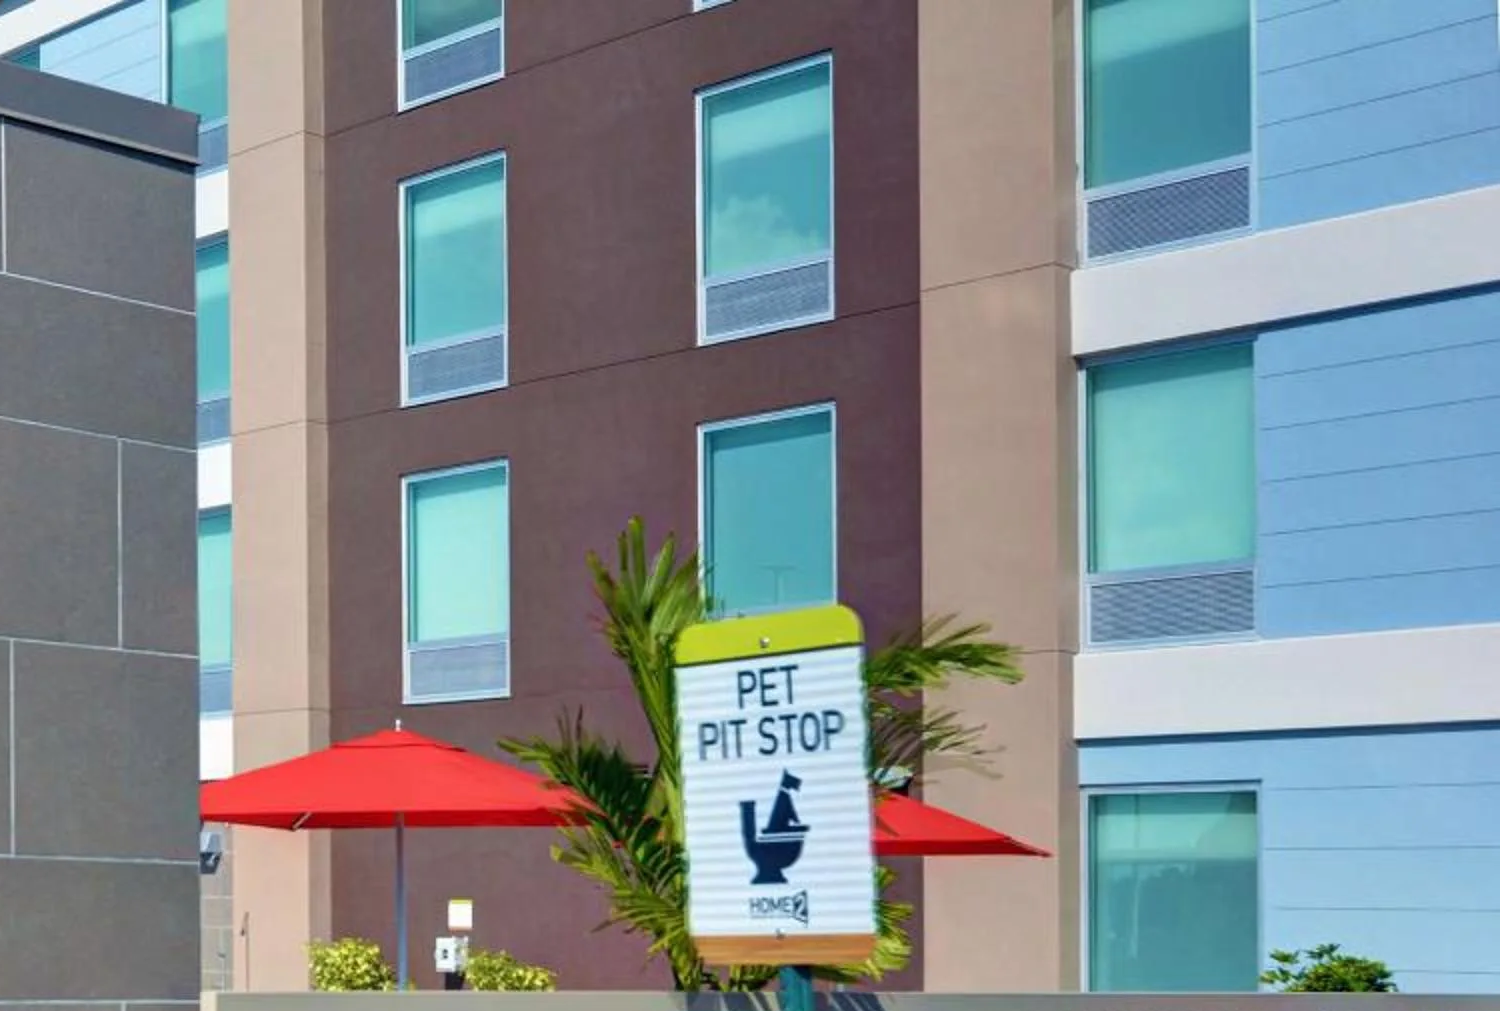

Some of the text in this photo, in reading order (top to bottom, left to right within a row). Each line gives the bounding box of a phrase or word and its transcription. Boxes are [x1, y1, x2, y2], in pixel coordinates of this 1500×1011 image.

[737, 665, 799, 709] PET
[699, 710, 845, 760] PIT STOP
